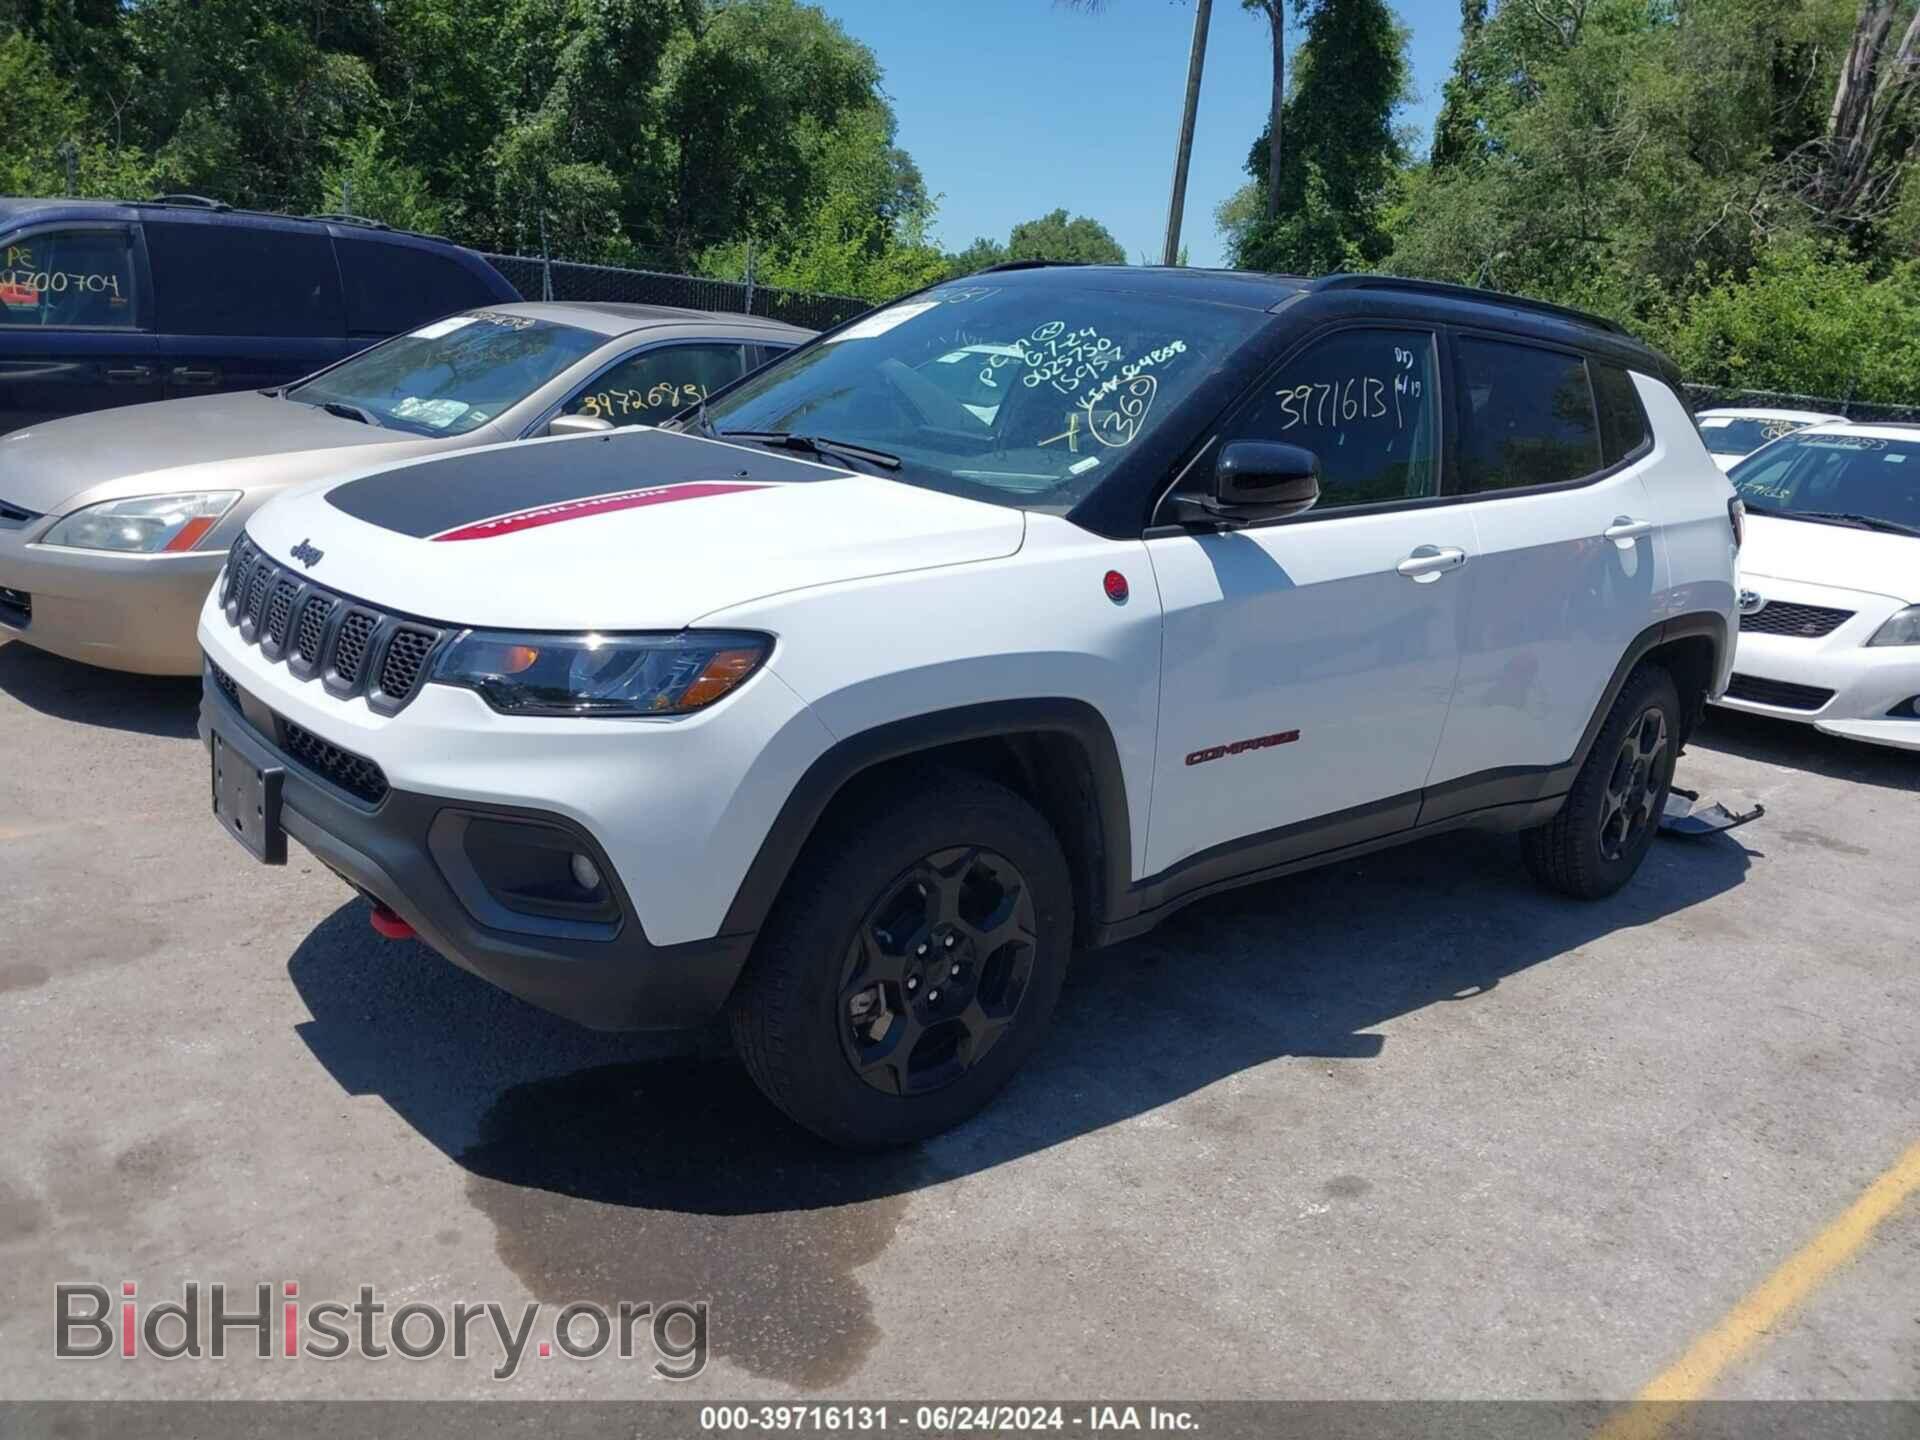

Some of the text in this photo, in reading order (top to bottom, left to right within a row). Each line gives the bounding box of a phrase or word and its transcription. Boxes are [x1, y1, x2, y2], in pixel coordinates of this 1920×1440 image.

[1103, 378, 1151, 440] 360
[1275, 375, 1402, 430] 39716131
[1184, 729, 1301, 767] COMPASS
